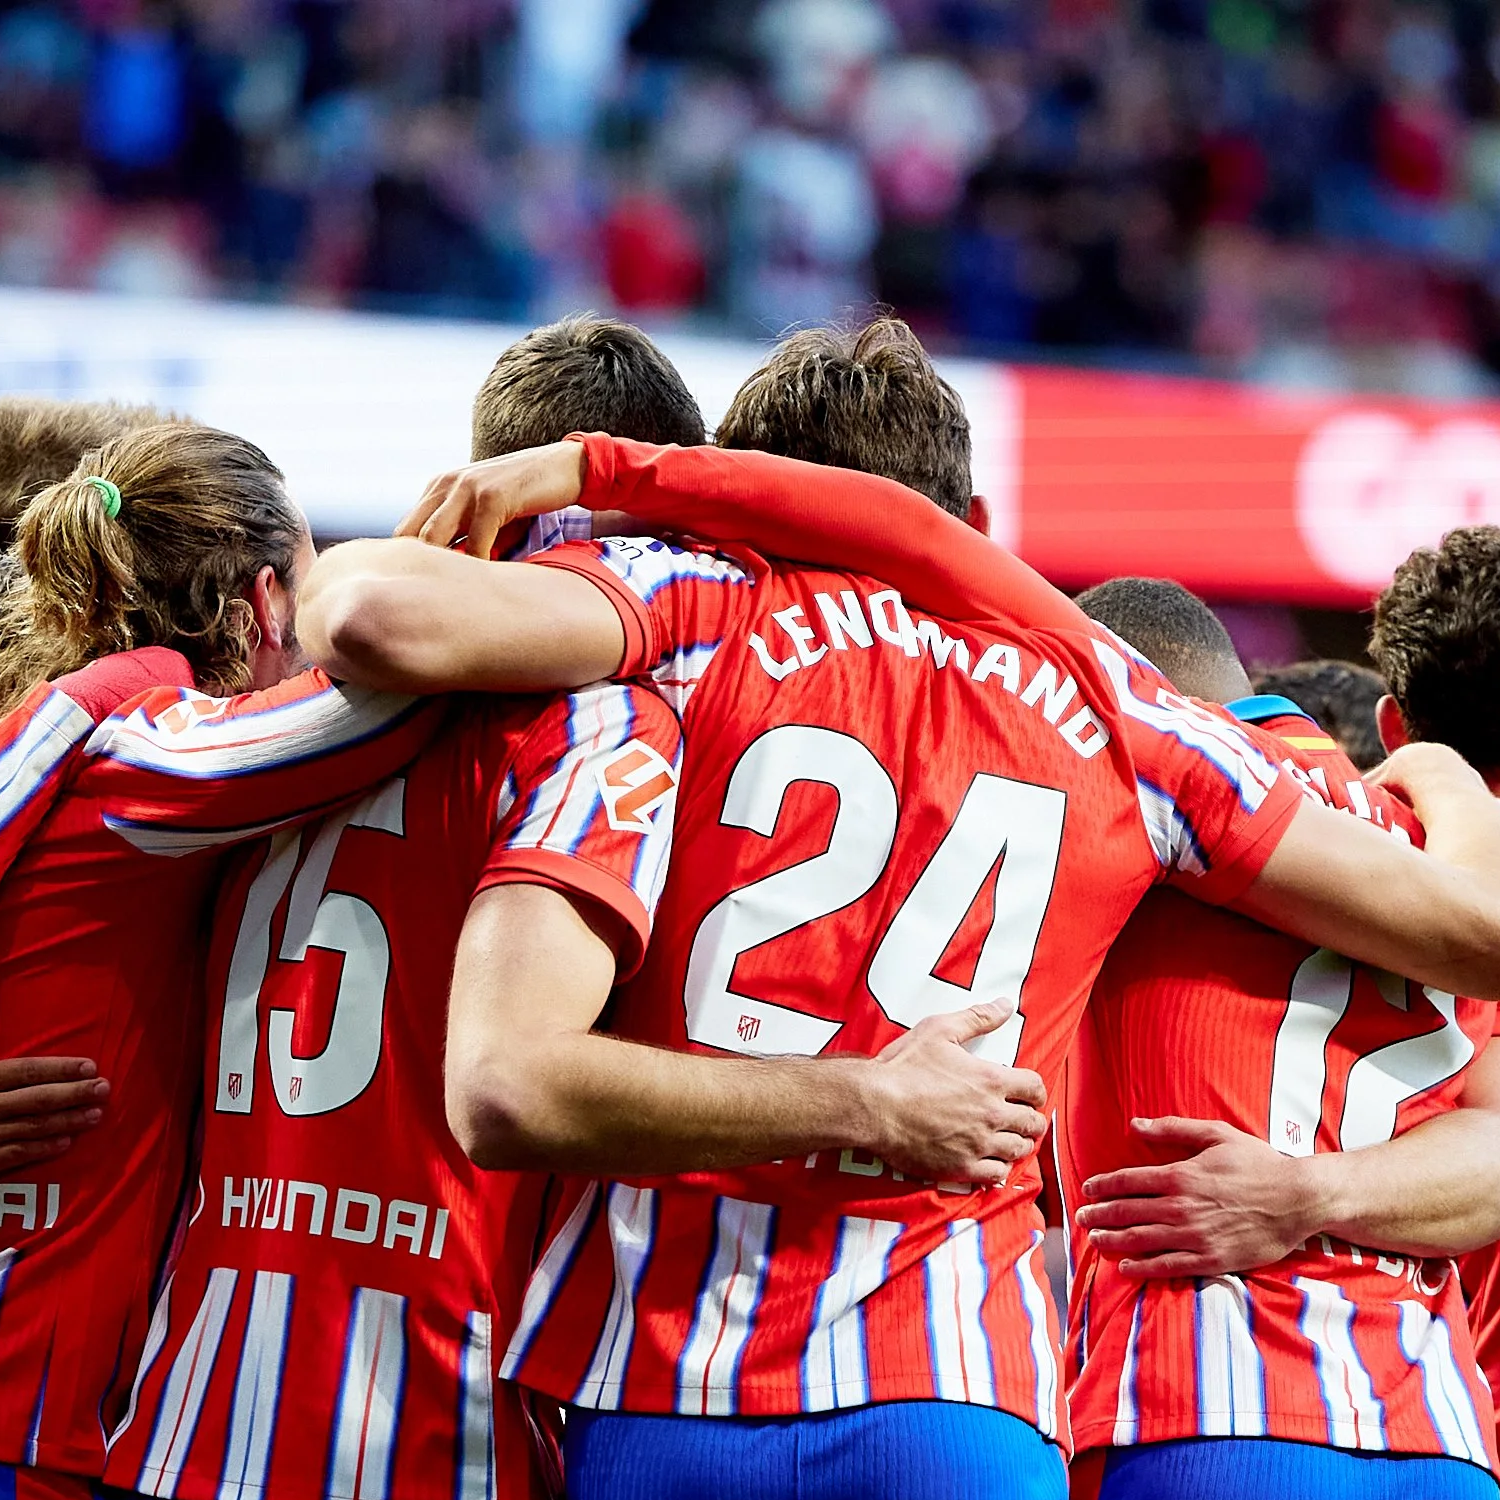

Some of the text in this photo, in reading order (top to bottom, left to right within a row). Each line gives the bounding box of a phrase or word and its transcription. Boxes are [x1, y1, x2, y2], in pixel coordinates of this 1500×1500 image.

[215, 777, 405, 1116] 15
[684, 724, 1068, 1070] 24
[221, 1176, 450, 1260] HYUNDAI
